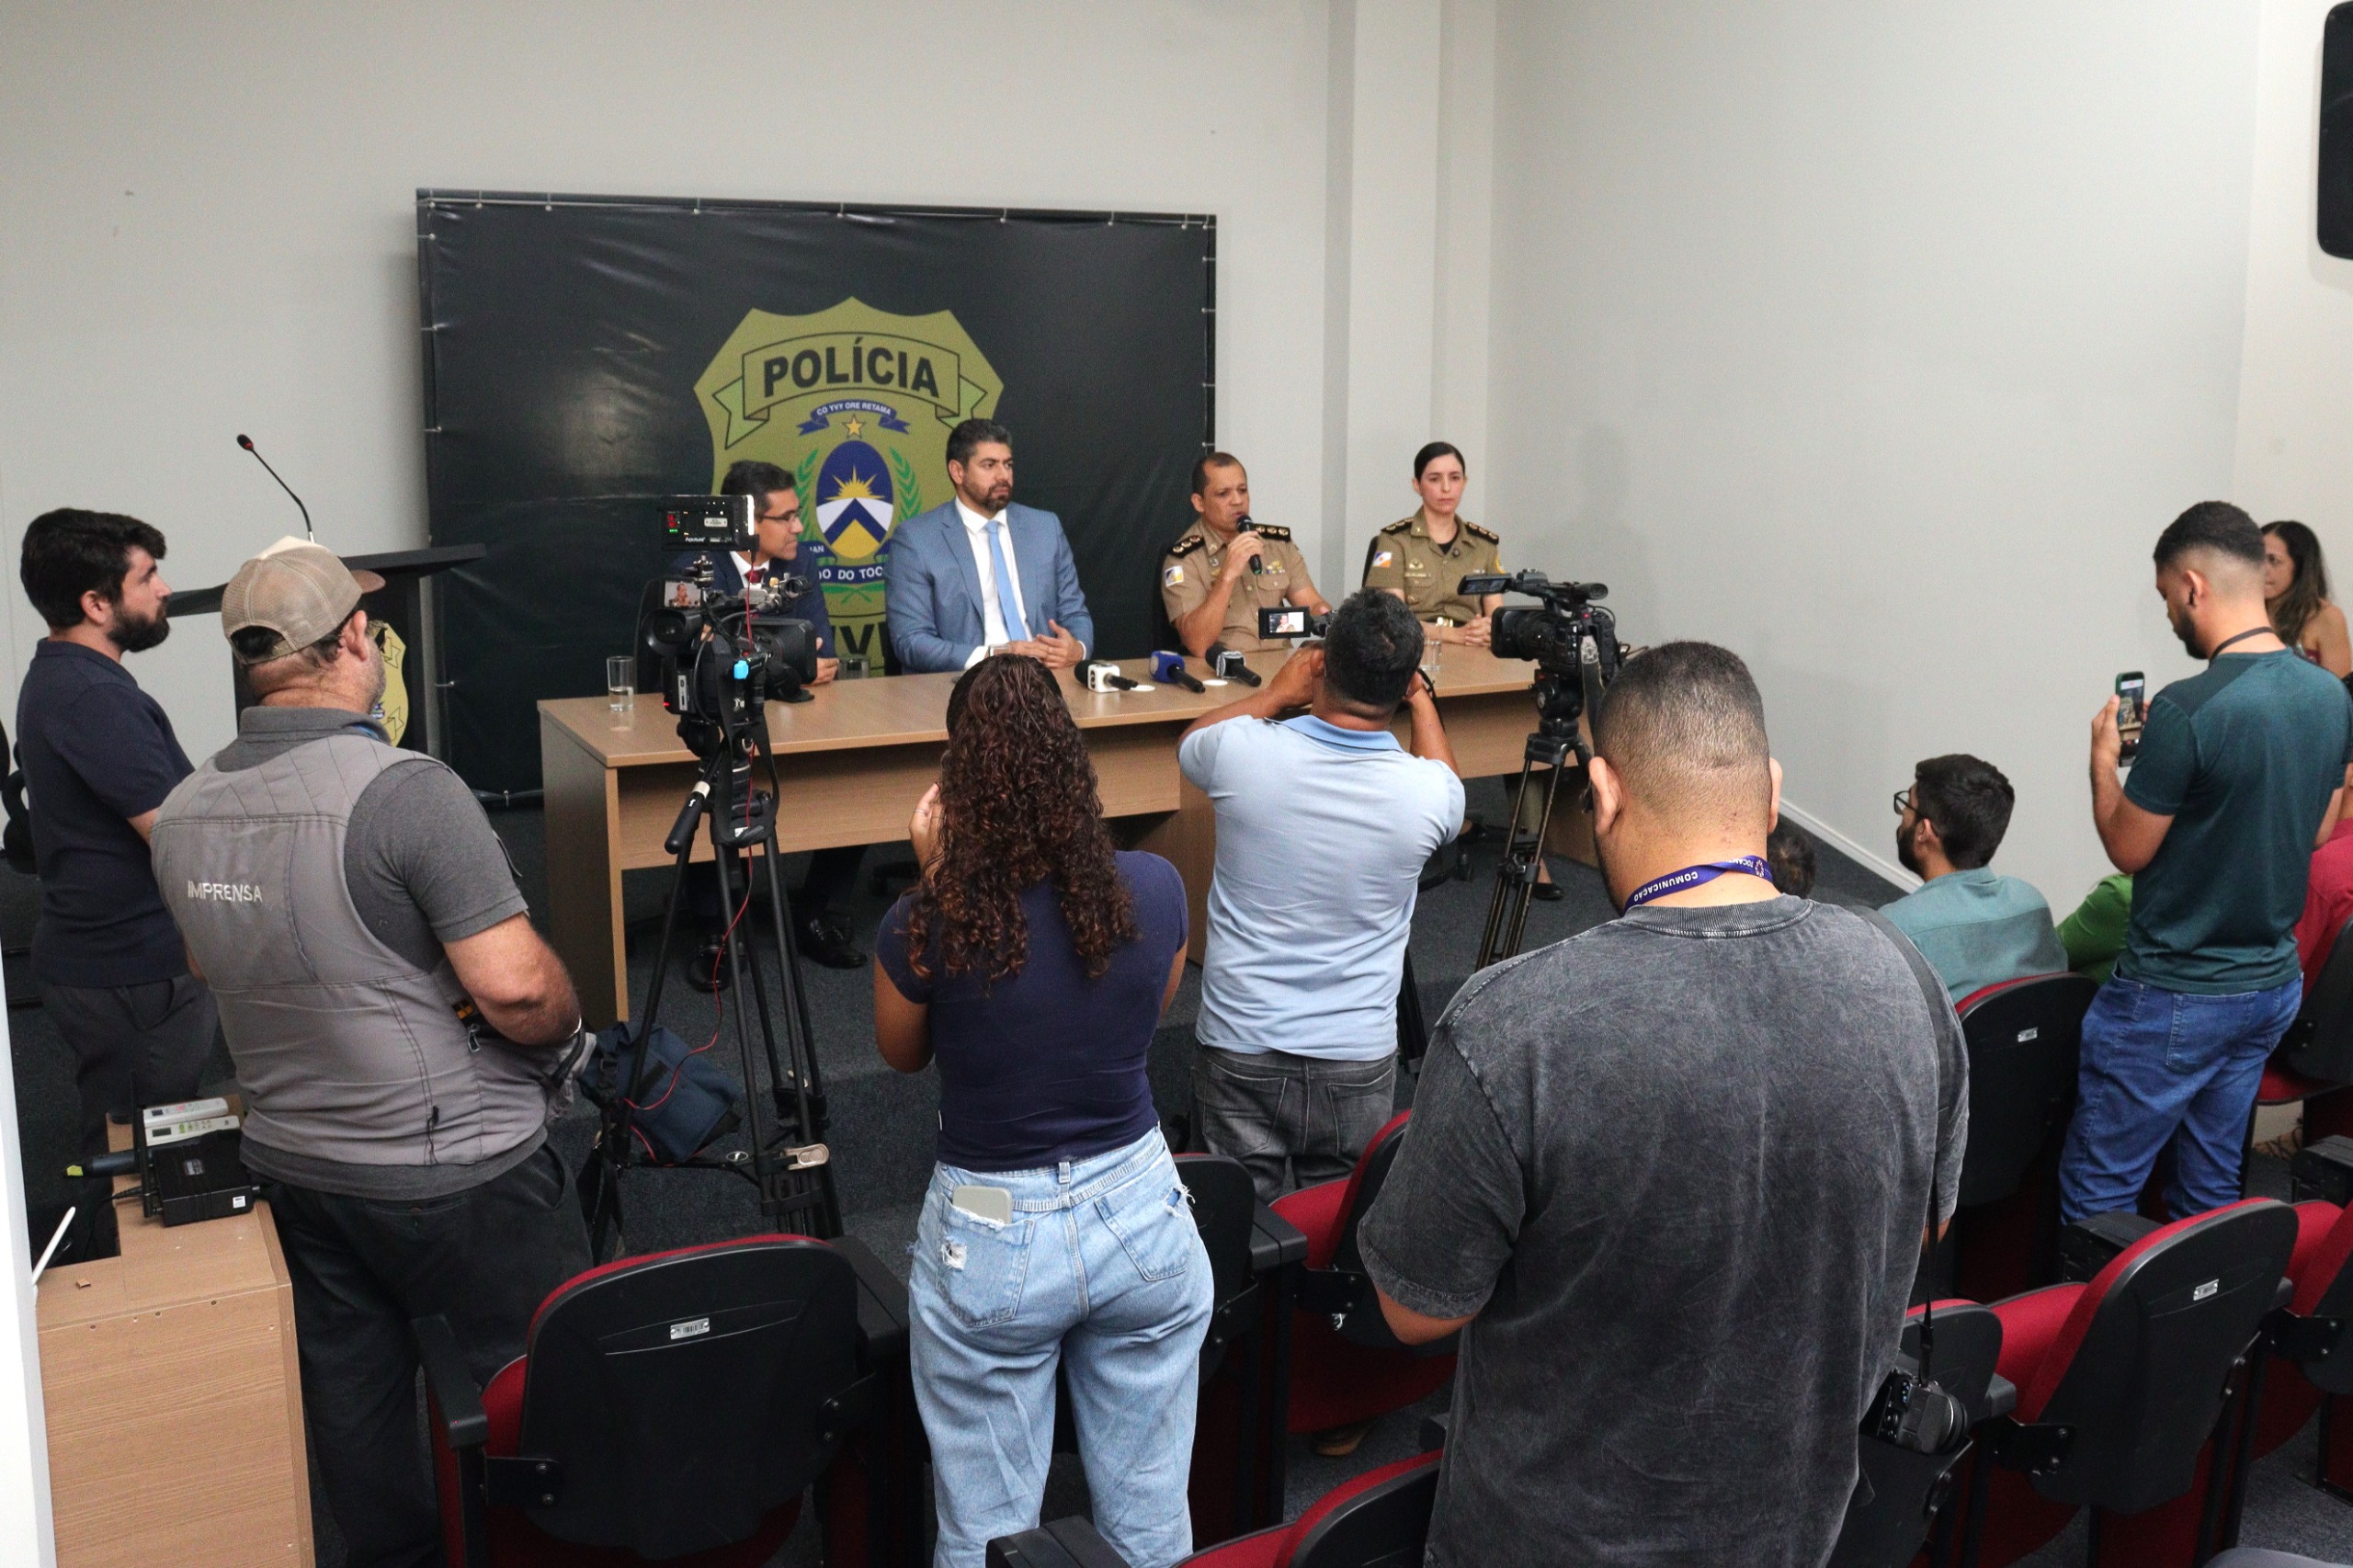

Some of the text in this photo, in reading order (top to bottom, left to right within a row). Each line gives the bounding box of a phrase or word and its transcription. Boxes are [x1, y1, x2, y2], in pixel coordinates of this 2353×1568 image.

[764, 336, 939, 398] POLÍCIA
[816, 406, 828, 415] CO
[829, 403, 844, 412] YVY
[862, 403, 892, 415] RETAMA
[819, 568, 831, 579] O
[837, 569, 855, 580] DO
[188, 880, 263, 903] IMPRENSA
